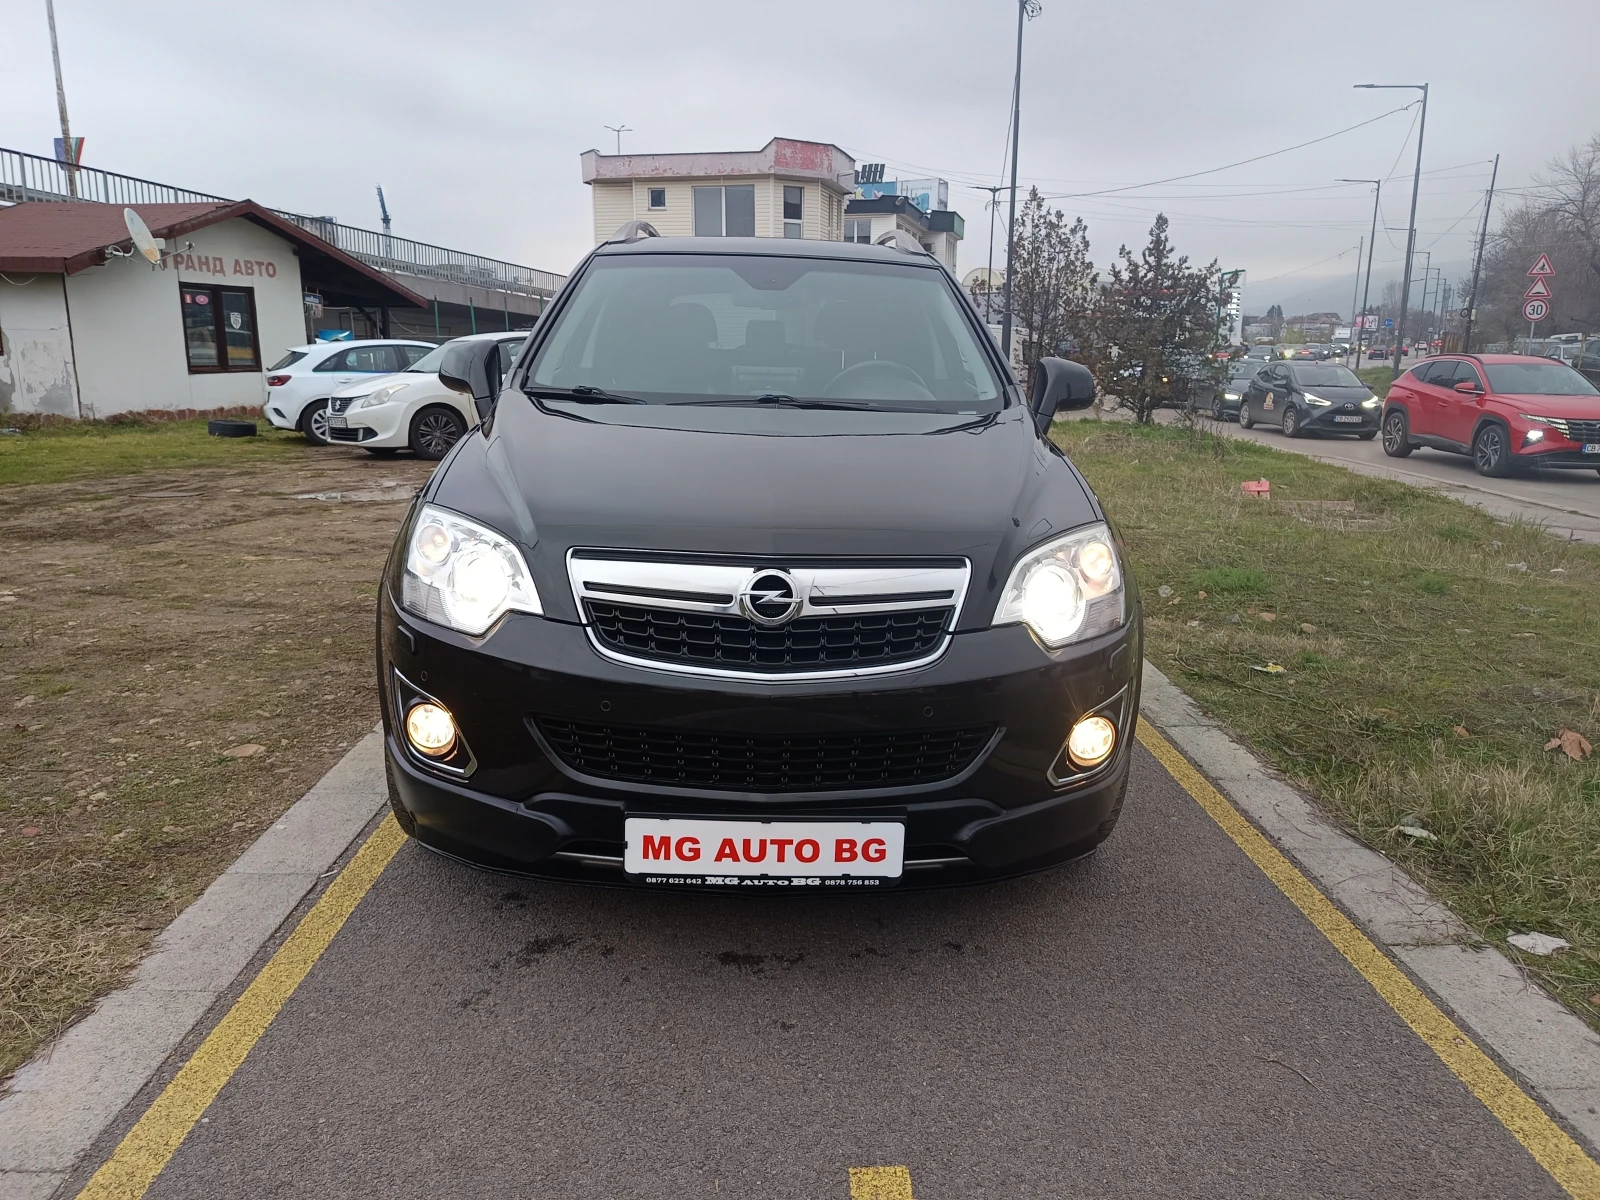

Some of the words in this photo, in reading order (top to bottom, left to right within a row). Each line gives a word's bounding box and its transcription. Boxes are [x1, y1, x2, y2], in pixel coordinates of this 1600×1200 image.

[161, 251, 226, 277] ГРАНД
[233, 259, 277, 278] АВТО
[1528, 304, 1543, 316] 30
[642, 835, 701, 862] MG
[714, 838, 820, 863] AUTO
[834, 838, 887, 863] BG
[705, 876, 740, 885] MG
[790, 877, 822, 886] BG
